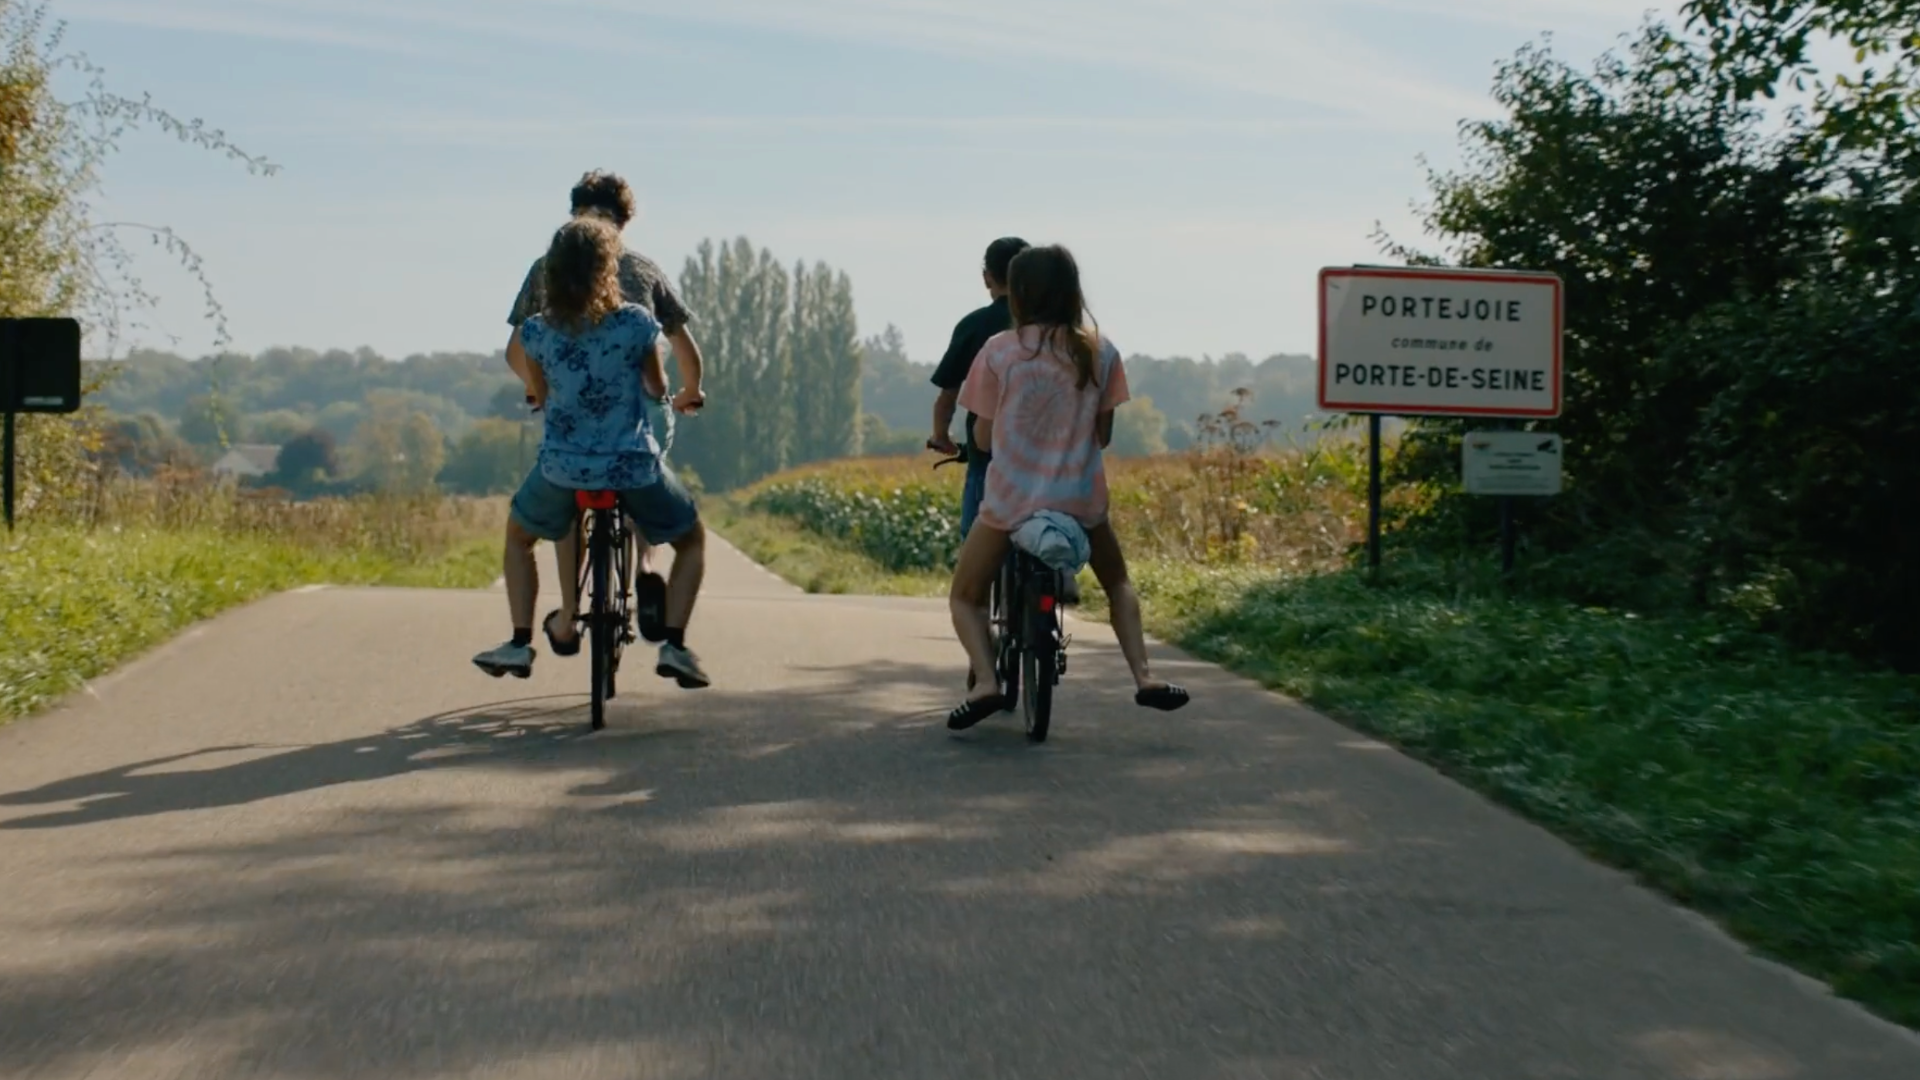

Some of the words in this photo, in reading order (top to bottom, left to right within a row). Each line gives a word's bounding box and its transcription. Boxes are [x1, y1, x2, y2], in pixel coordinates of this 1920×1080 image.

[1362, 295, 1521, 322] PORTEJOIE
[1391, 337, 1468, 351] commune
[1473, 336, 1494, 352] de
[1335, 363, 1545, 391] PORTE-DE-SEINE
